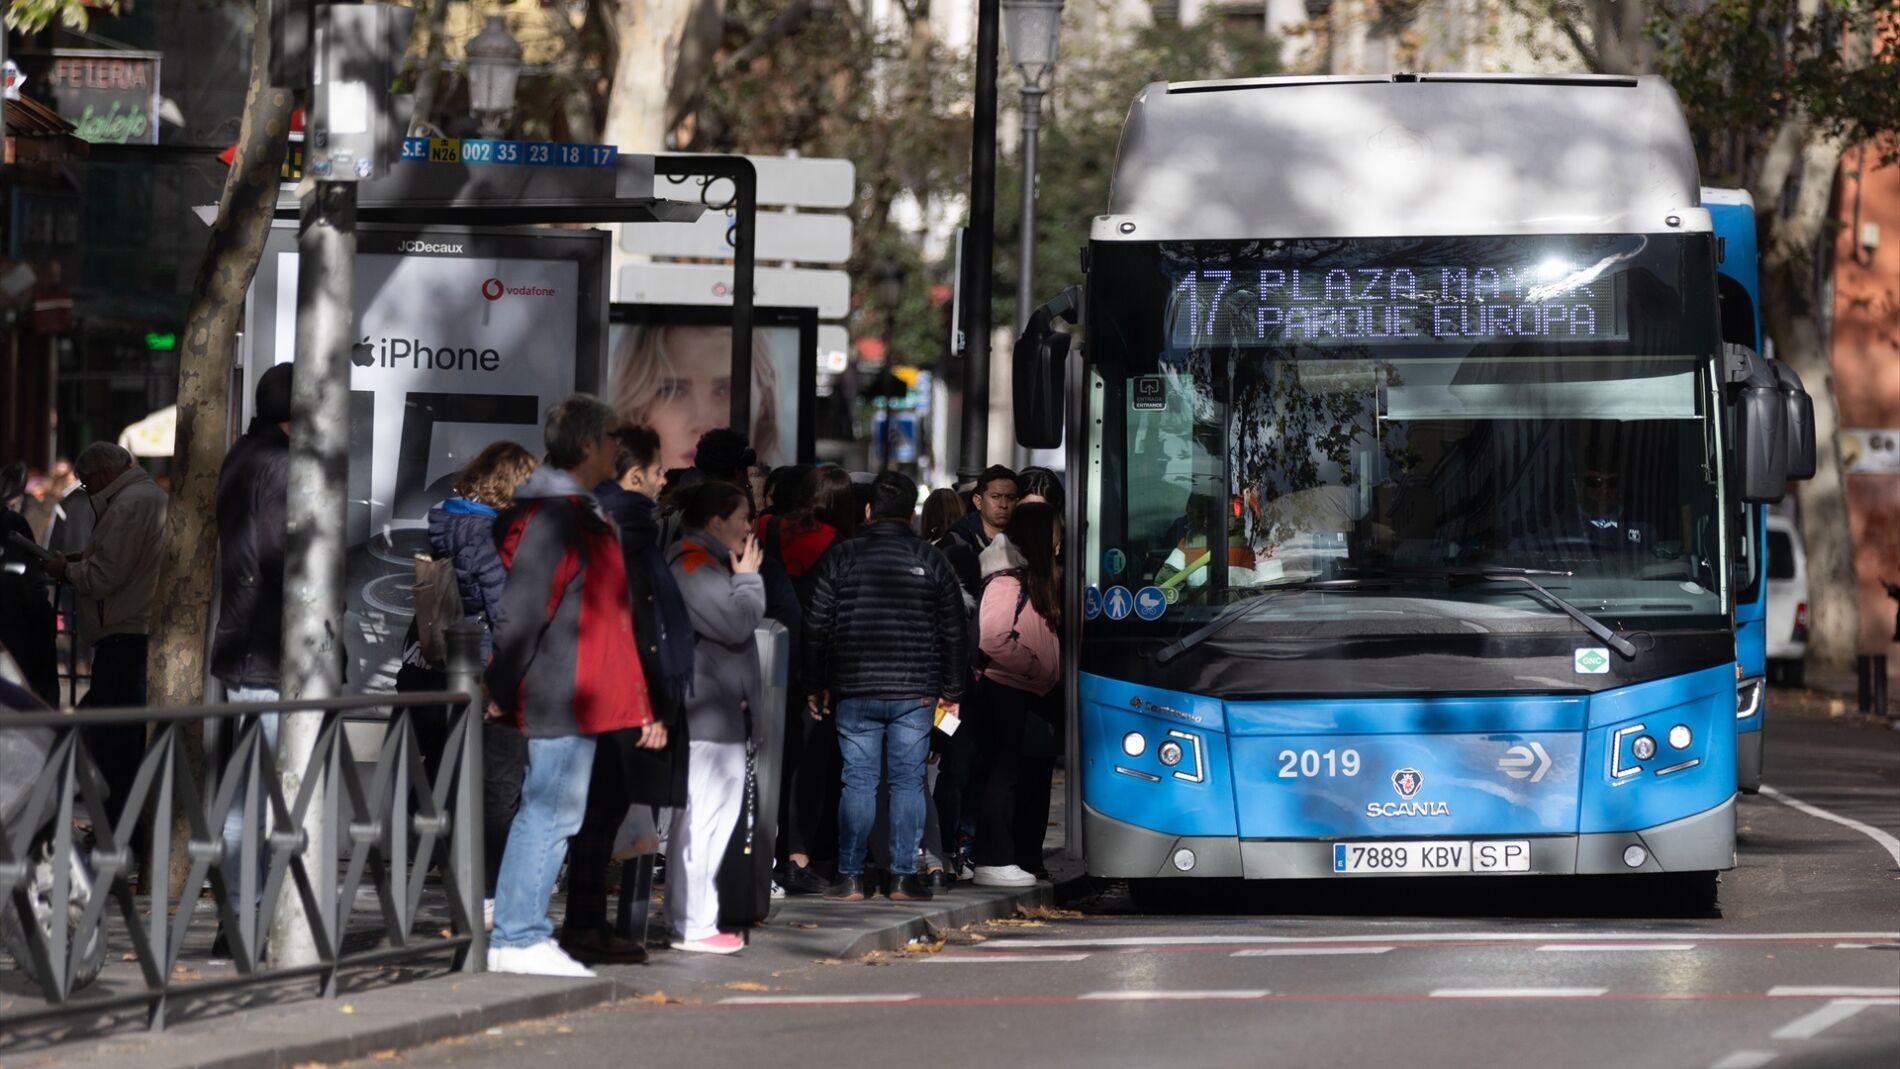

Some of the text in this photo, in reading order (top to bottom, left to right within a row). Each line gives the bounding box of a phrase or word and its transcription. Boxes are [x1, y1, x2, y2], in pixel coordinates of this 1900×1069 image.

[432, 149, 457, 161] N26
[462, 142, 490, 160] 002
[497, 143, 517, 160] 35
[529, 145, 549, 162] 23
[561, 146, 580, 163] 18
[592, 148, 610, 165] 17
[398, 240, 463, 254] JCDecaux
[506, 286, 555, 297] vodafone
[1176, 267, 1595, 336] 17 PLAZA MAY
[1257, 304, 1595, 338] PARQUE EUROPA
[381, 338, 500, 371] iPhone
[1167, 589, 1175, 600] 3
[1582, 657, 1602, 665] GNC
[1278, 749, 1361, 778] 2019
[1366, 801, 1450, 817] SCANIA
[1353, 847, 1408, 868] 7889
[1422, 846, 1463, 868] KBV
